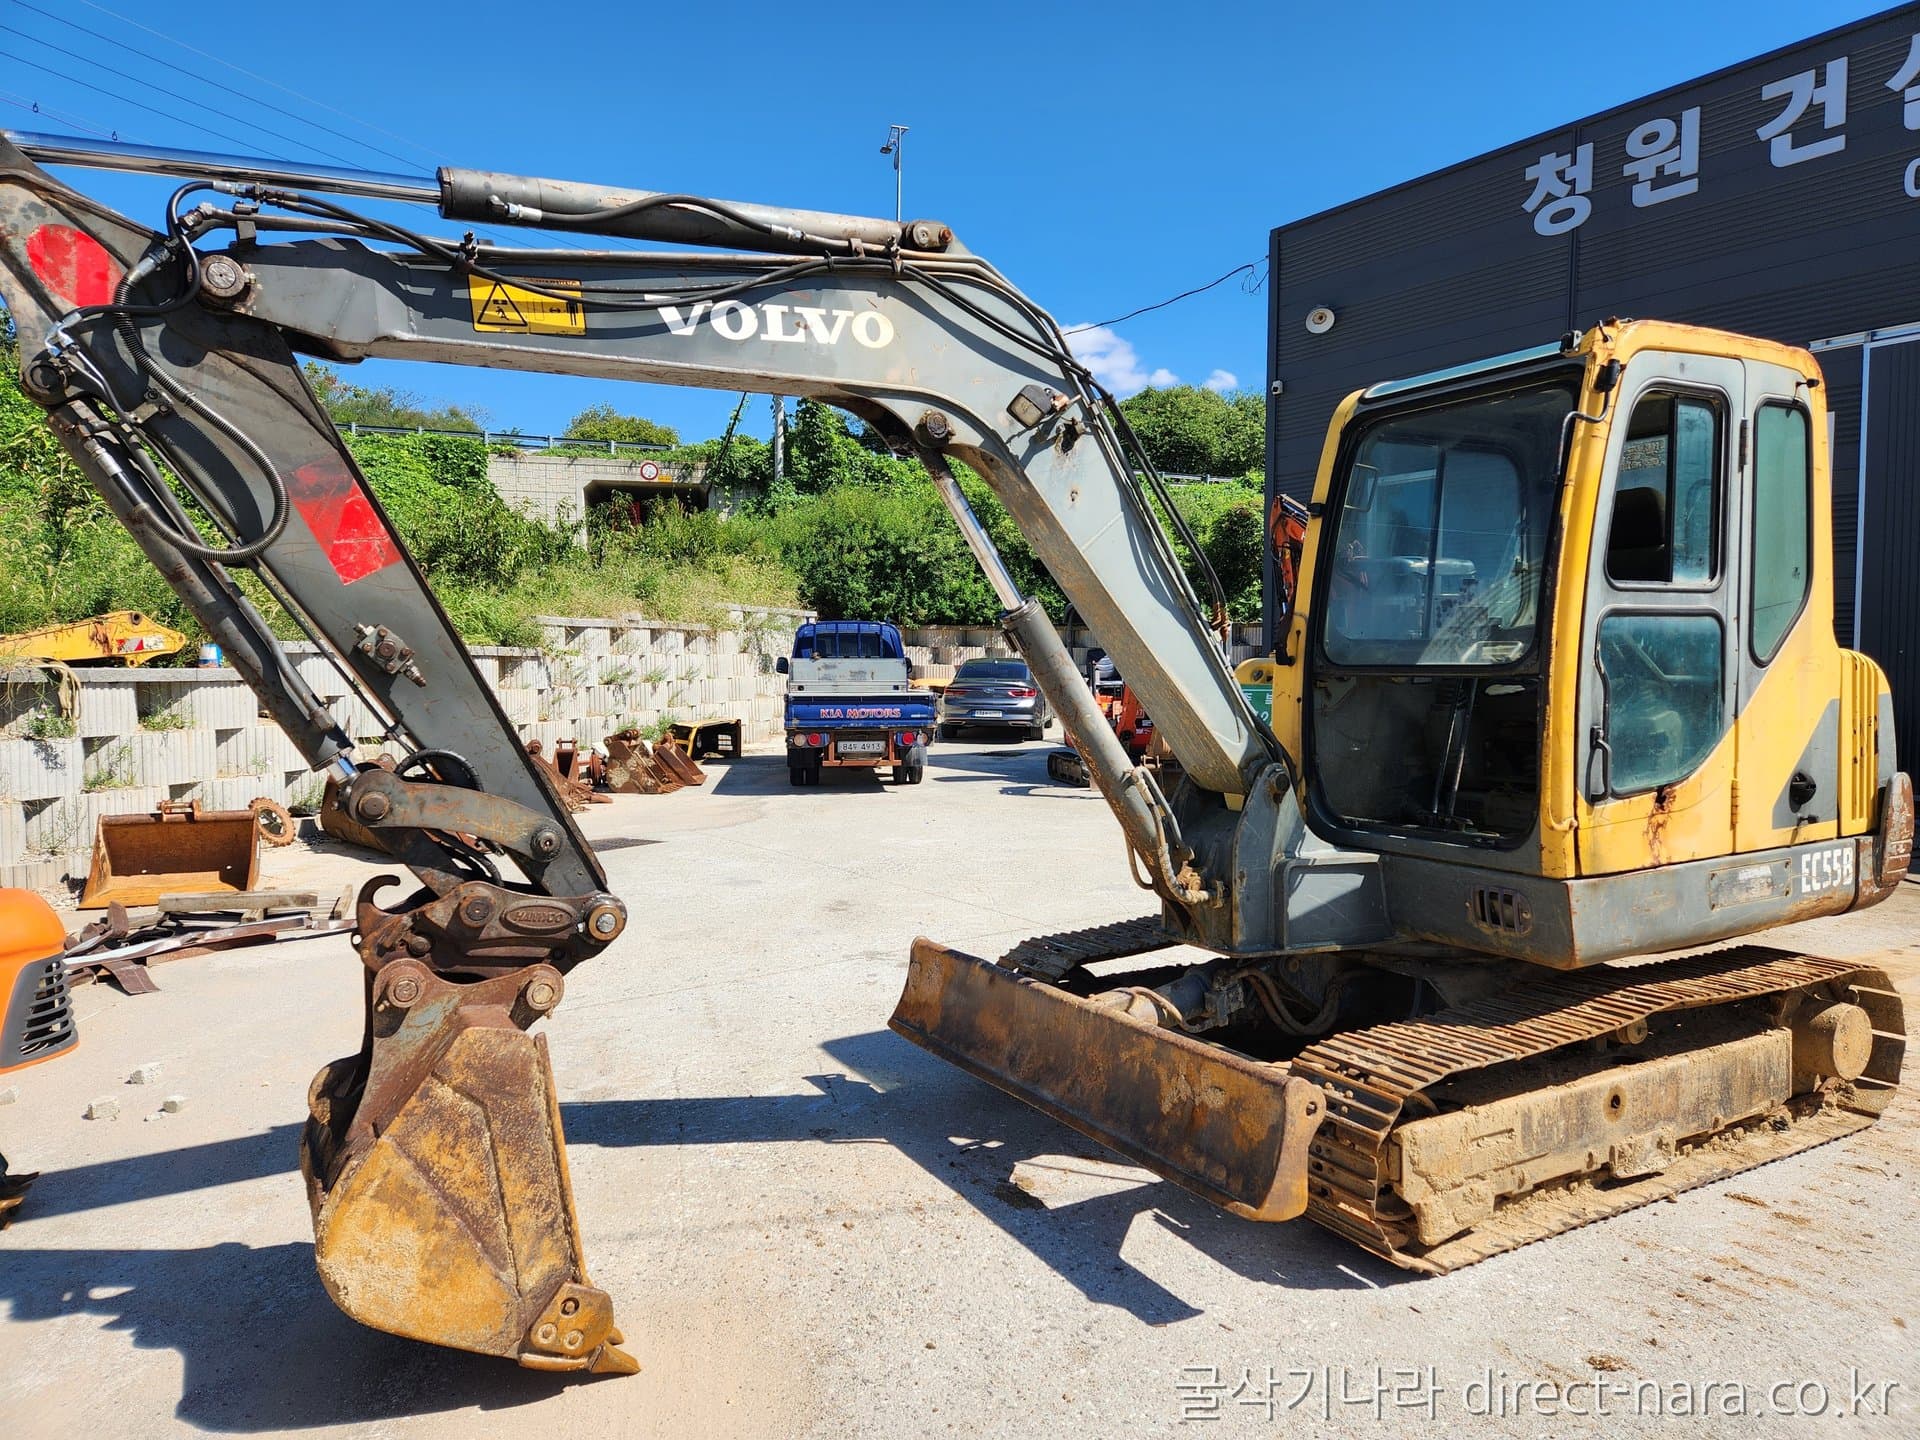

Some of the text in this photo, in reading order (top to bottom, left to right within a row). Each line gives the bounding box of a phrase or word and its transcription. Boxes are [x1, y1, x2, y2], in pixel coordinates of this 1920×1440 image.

[644, 294, 895, 349] VOLVO
[820, 708, 902, 719] KIA MOTORS
[1801, 847, 1853, 893] EC55B
